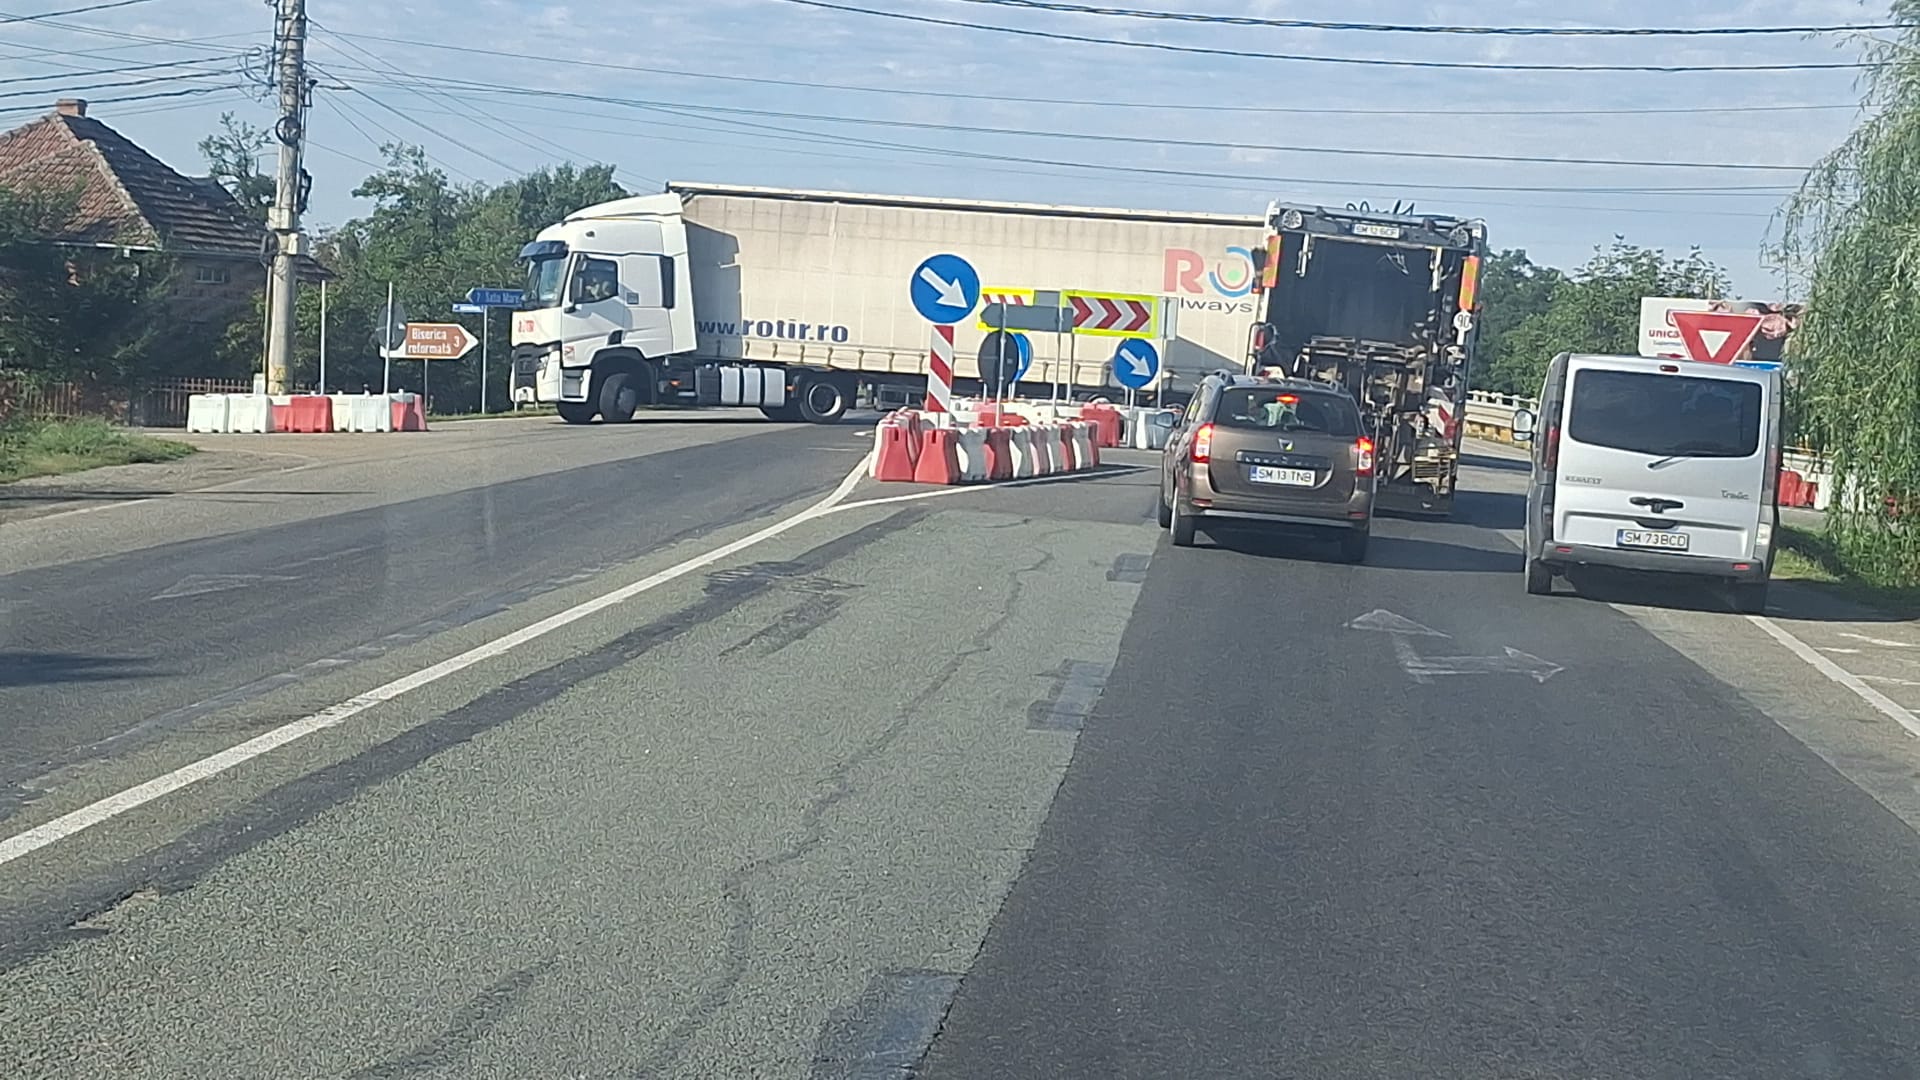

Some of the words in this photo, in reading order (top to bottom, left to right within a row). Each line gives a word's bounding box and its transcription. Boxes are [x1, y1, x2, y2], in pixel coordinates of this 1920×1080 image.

[1180, 297, 1253, 315] lways
[411, 328, 447, 340] Biserica
[696, 319, 848, 343] ww.rotir.ro
[1649, 329, 1679, 338] unica
[454, 336, 461, 348] 3
[1258, 468, 1273, 479] SM
[1277, 470, 1287, 480] 13
[1291, 471, 1312, 482] TNB
[1625, 532, 1641, 543] SM
